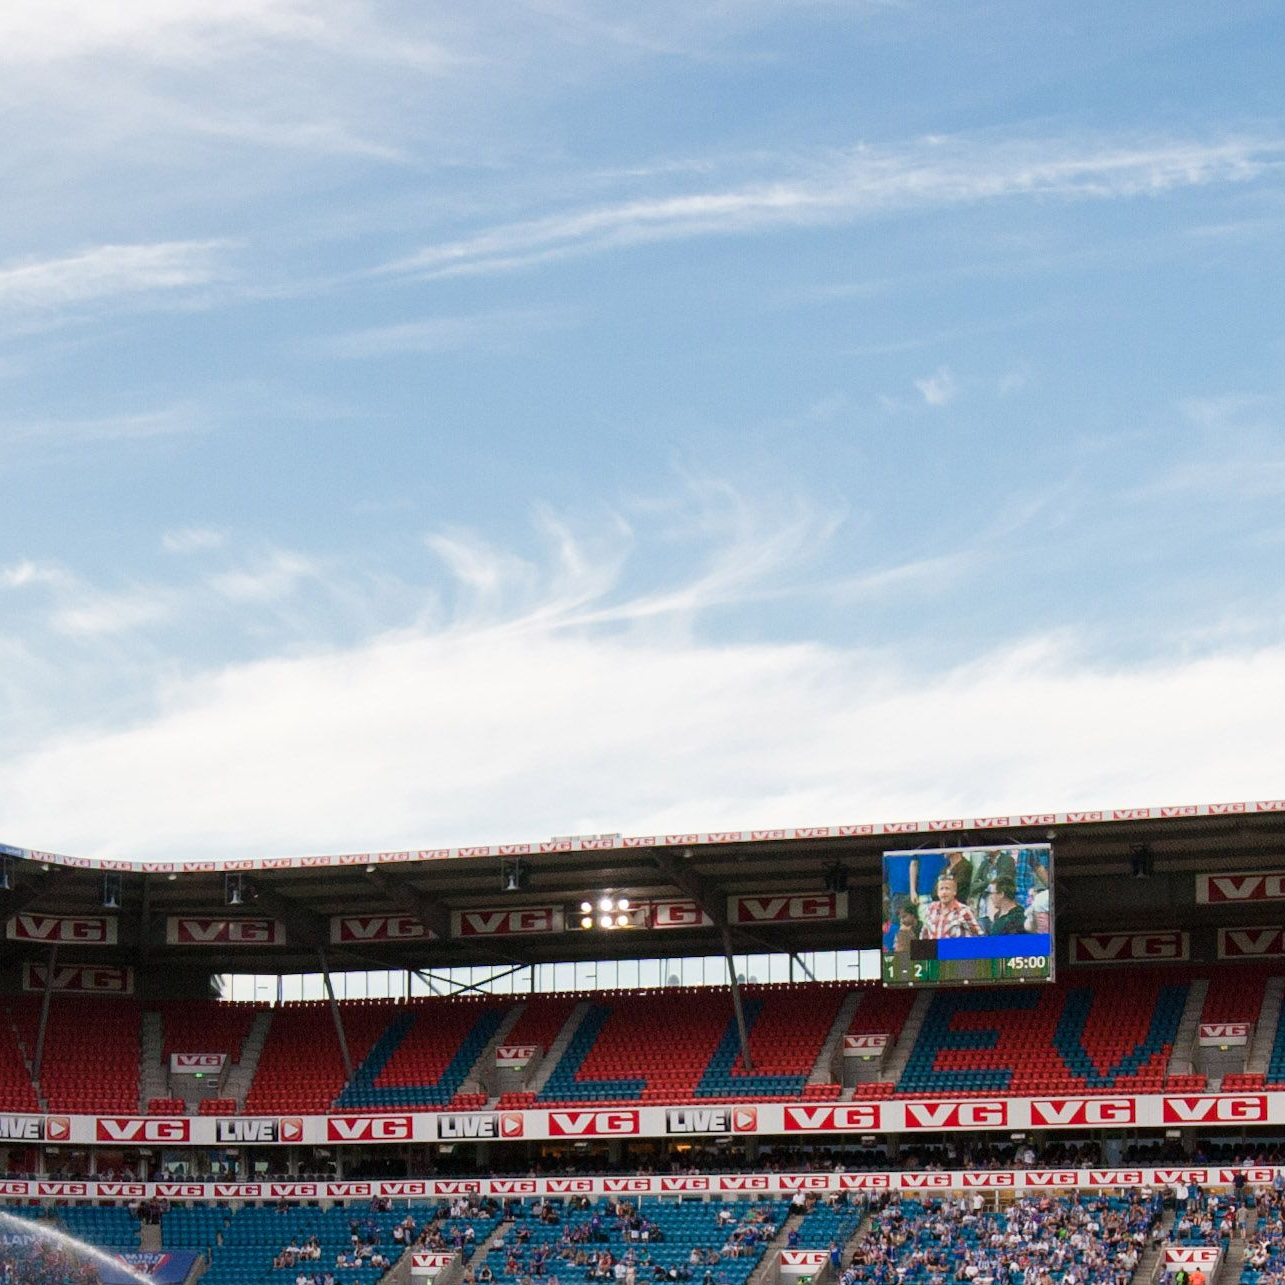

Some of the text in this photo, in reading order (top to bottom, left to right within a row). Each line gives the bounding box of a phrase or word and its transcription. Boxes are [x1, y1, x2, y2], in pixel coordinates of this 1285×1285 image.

[742, 896, 833, 920] VG
[465, 910, 550, 934] VG
[19, 917, 104, 940] VG
[182, 921, 272, 942] VG
[1007, 956, 1045, 969] 45:00
[888, 964, 922, 978] 1 2
[1202, 1025, 1247, 1037] VG
[846, 1036, 887, 1048] VG
[498, 1047, 535, 1059] VG
[179, 1055, 220, 1066] VG
[910, 1104, 1004, 1126] VG
[1035, 1101, 1132, 1124] VG
[1167, 1098, 1264, 1121] VG
[553, 1112, 636, 1134] VG
[669, 1109, 730, 1131] LIVE
[789, 1107, 877, 1128] VG
[100, 1120, 186, 1140] VG
[220, 1119, 278, 1141] LIVE
[331, 1118, 410, 1139] VG
[440, 1116, 497, 1137] LIVE
[722, 1177, 767, 1188] VG
[842, 1175, 888, 1187] VG
[903, 1175, 949, 1186] VG
[965, 1174, 1012, 1185] VG
[1028, 1173, 1076, 1184] VG
[1092, 1172, 1140, 1183] VG
[1156, 1171, 1206, 1182] VG
[99, 1184, 144, 1195] VG
[329, 1184, 369, 1195] VG
[329, 1184, 369, 1195] VG
[383, 1183, 423, 1194] VG
[492, 1182, 534, 1192] VG
[549, 1180, 591, 1191] VG
[663, 1178, 707, 1189] VG
[217, 1185, 259, 1196] VG
[413, 1255, 453, 1266] VG
[782, 1252, 828, 1264] VG
[1168, 1250, 1217, 1262] VG
